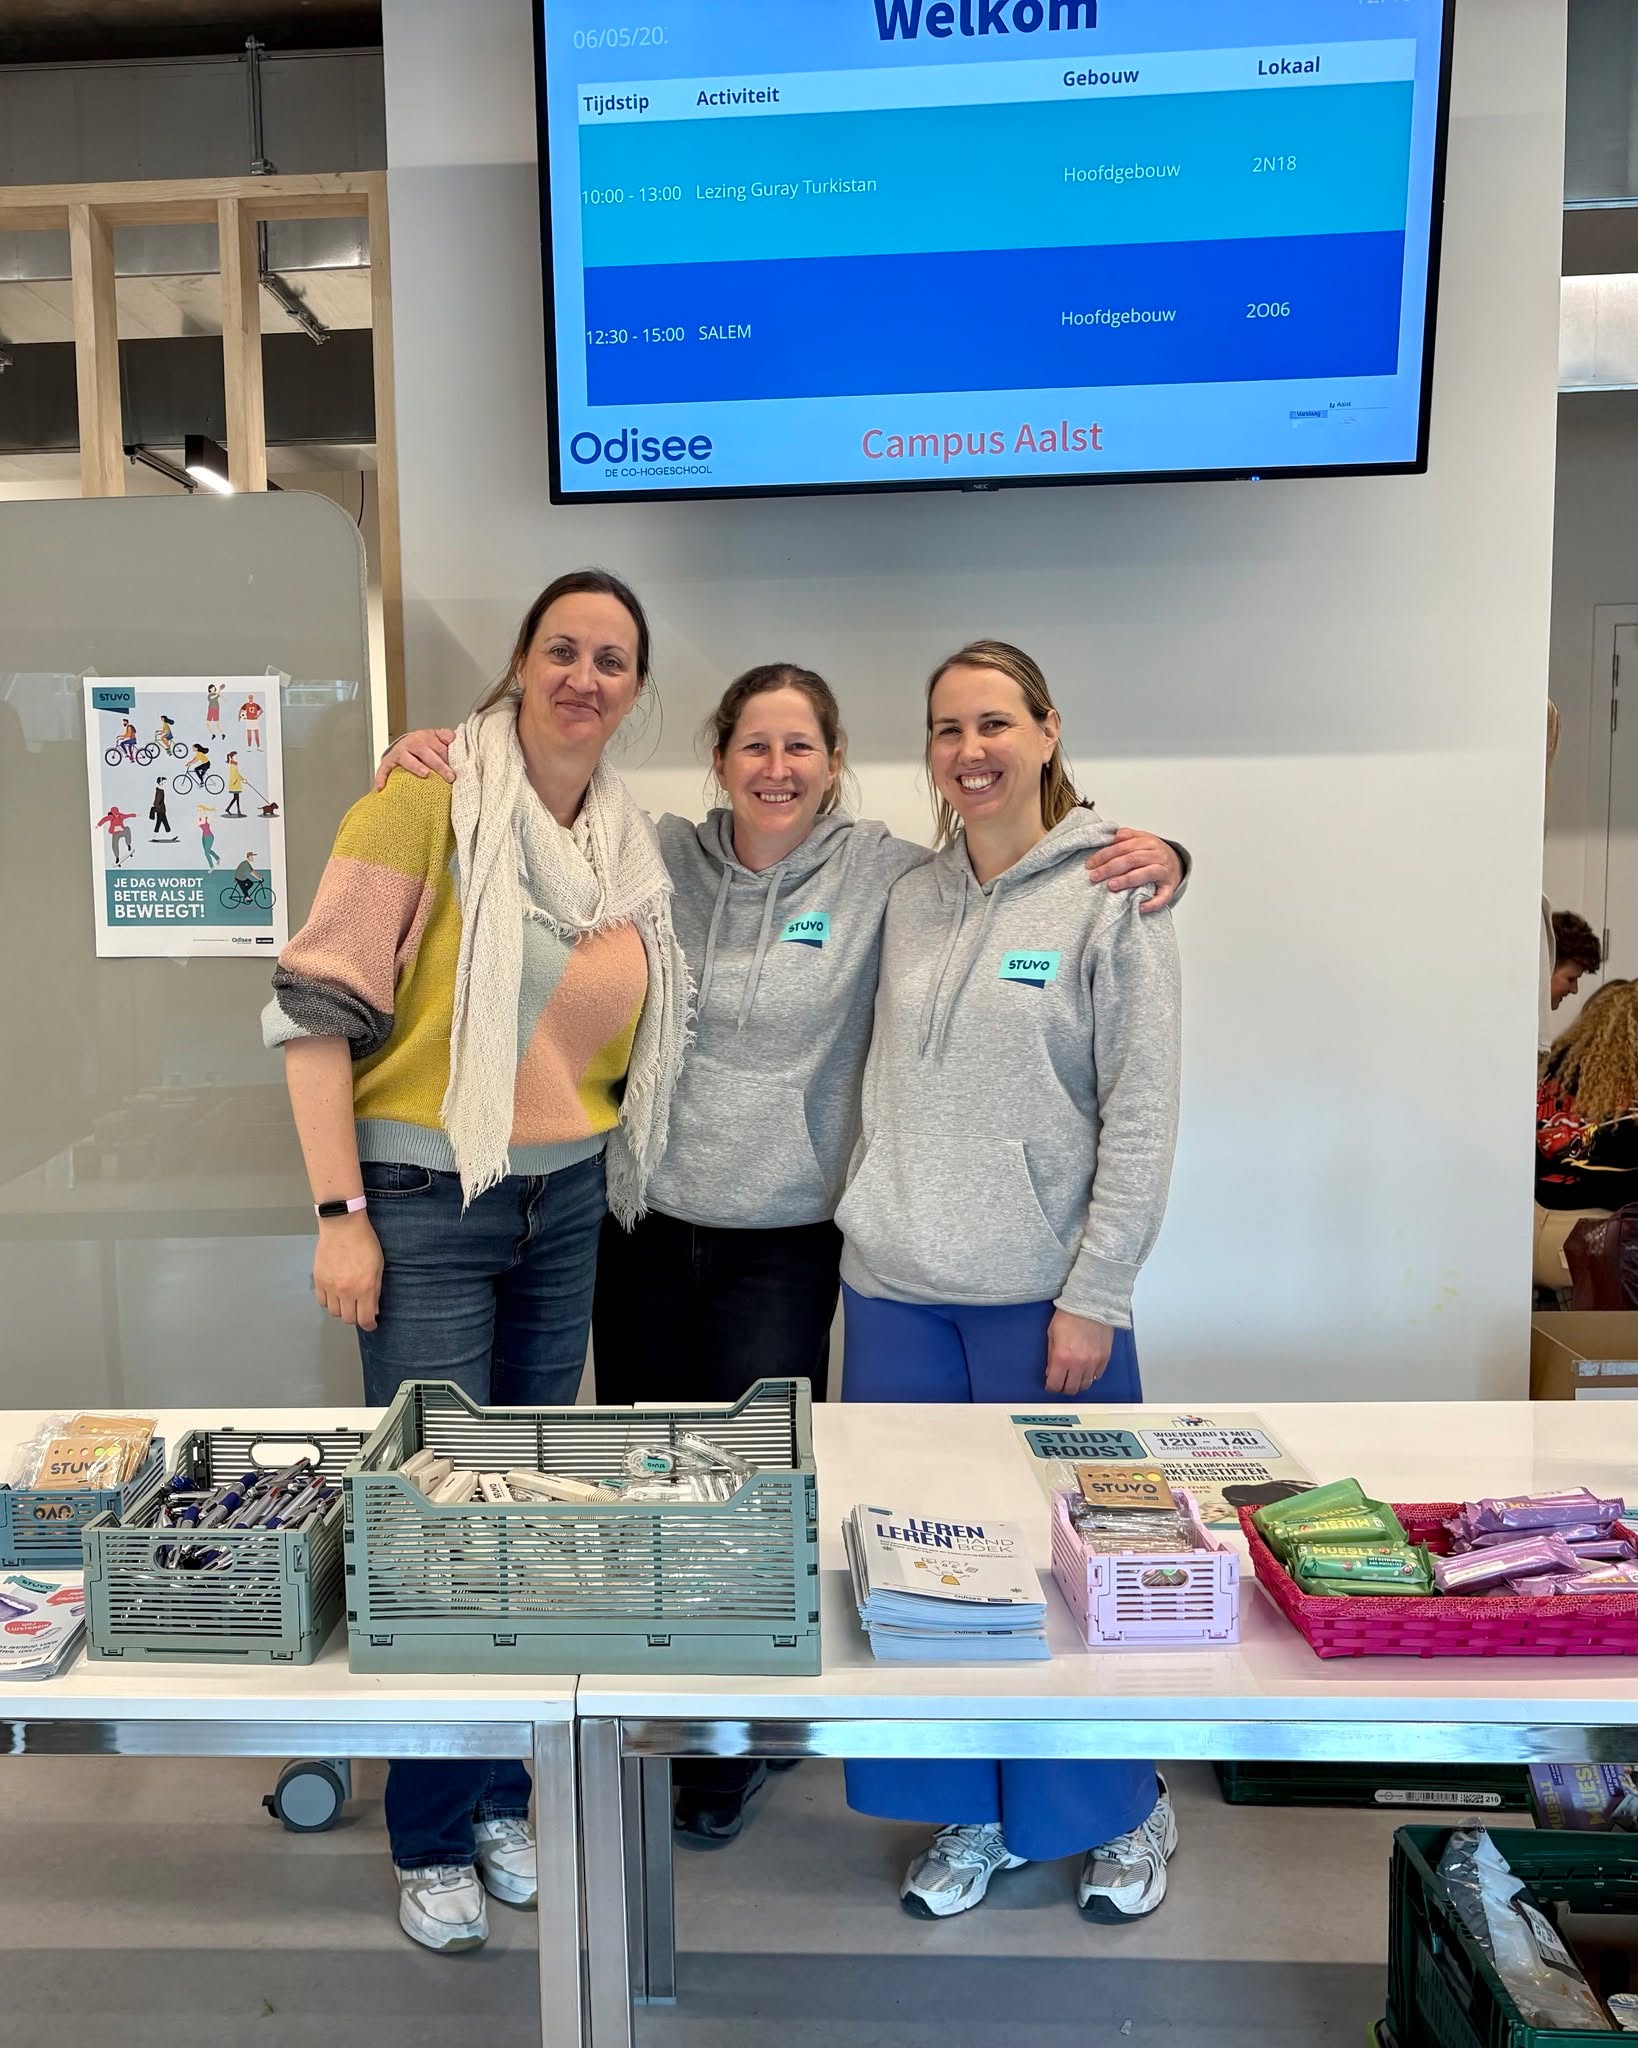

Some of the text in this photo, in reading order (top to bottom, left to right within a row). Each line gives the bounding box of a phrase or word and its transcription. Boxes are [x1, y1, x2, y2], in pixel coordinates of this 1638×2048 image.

[873, 0, 1098, 41] Welkom
[573, 25, 669, 49] 06/05/20
[583, 56, 1321, 115] Tijdstip Activiteit Gebouw Lokaal
[581, 188, 624, 206] 10:00
[638, 185, 682, 203] 13:00
[695, 182, 747, 203] Lezing
[750, 180, 799, 201] Guray
[802, 176, 878, 196] Turkistan
[1063, 163, 1182, 185] Hoofdgebouw
[1251, 155, 1297, 173] 2N18
[585, 328, 629, 346] 12:30
[642, 326, 686, 344] 15:00
[697, 324, 752, 341] SALEM
[1060, 306, 1177, 328] Hoofdgebouw
[570, 428, 713, 464] Odisee
[860, 421, 1104, 465] Campus Aalst
[605, 465, 713, 477] DE CO-HOGESCHOOL
[99, 692, 130, 702] STUVO
[113, 877, 204, 888] JE DAG WORDT
[114, 890, 204, 902] BETER ALS JE
[114, 903, 205, 919] BEWEEGT!
[788, 920, 824, 933] STUVO
[1008, 959, 1050, 971] STUVO
[1034, 1431, 1123, 1444] STUDY
[1157, 1437, 1196, 1447] 12U
[1220, 1436, 1259, 1446] 14U
[1040, 1445, 1133, 1458] BOOST
[1191, 1450, 1244, 1458] GRATIS
[50, 1461, 109, 1475] STUVO
[1163, 1468, 1270, 1476] RKEERSTIFTEN
[1091, 1482, 1158, 1494] STUVO
[908, 1518, 985, 1539] LEREN
[876, 1523, 953, 1549] LEREN
[956, 1537, 1014, 1546] HAND
[957, 1543, 1013, 1553] BOEK
[22, 1579, 53, 1590] STUVO
